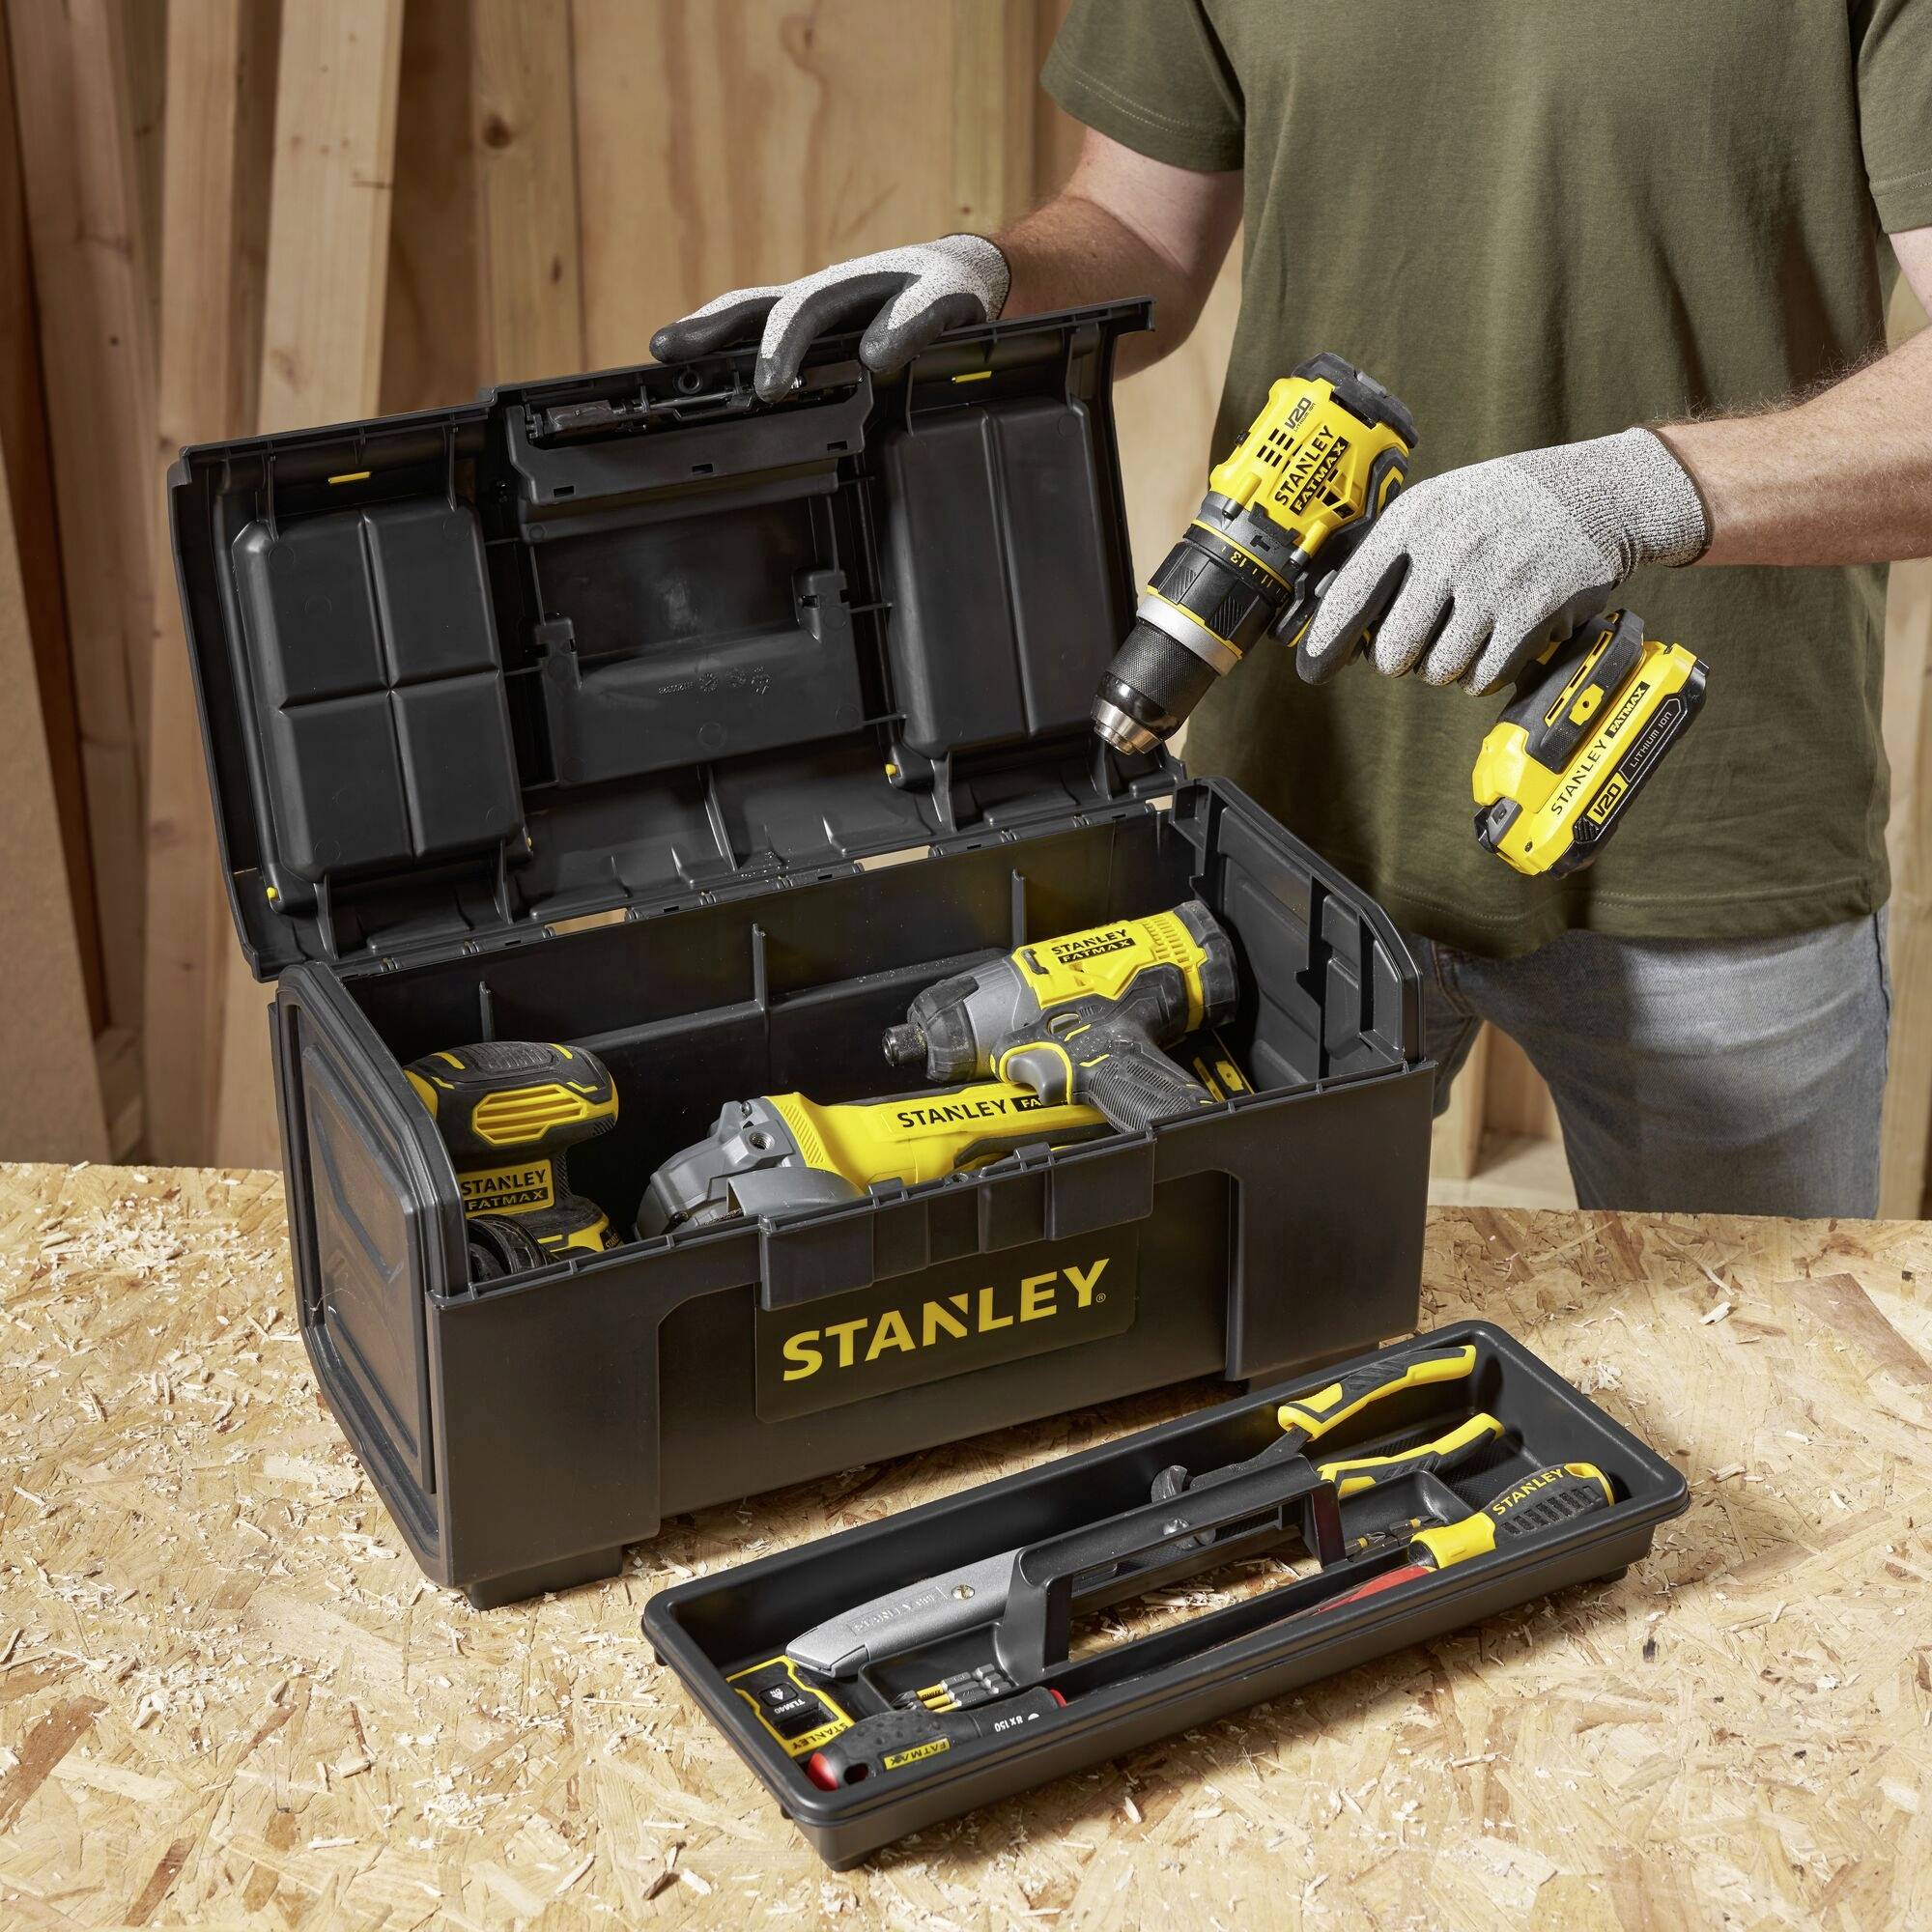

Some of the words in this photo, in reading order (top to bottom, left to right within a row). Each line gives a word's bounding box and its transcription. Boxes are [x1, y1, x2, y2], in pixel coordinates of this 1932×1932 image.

[1284, 397, 1312, 431] V20
[1274, 425, 1335, 506] STANLEY
[1295, 443, 1348, 511] FATMAX
[1550, 738, 1607, 815] STANLEY
[1608, 686, 1646, 733] FATMAX
[1593, 782, 1622, 818] V20
[1630, 730, 1659, 768] LITHIUM
[1050, 928, 1127, 955] STANLEY
[1062, 940, 1130, 963] FATMAX
[896, 1098, 1008, 1128] STANLEY
[460, 1168, 546, 1196] STANLEY
[469, 1190, 544, 1211] FATMAX
[1492, 1468, 1565, 1515] STANLEY
[773, 1697, 806, 1716] TLM40
[792, 1721, 849, 1750] STANLEY
[890, 1742, 948, 1766] FATMAX
